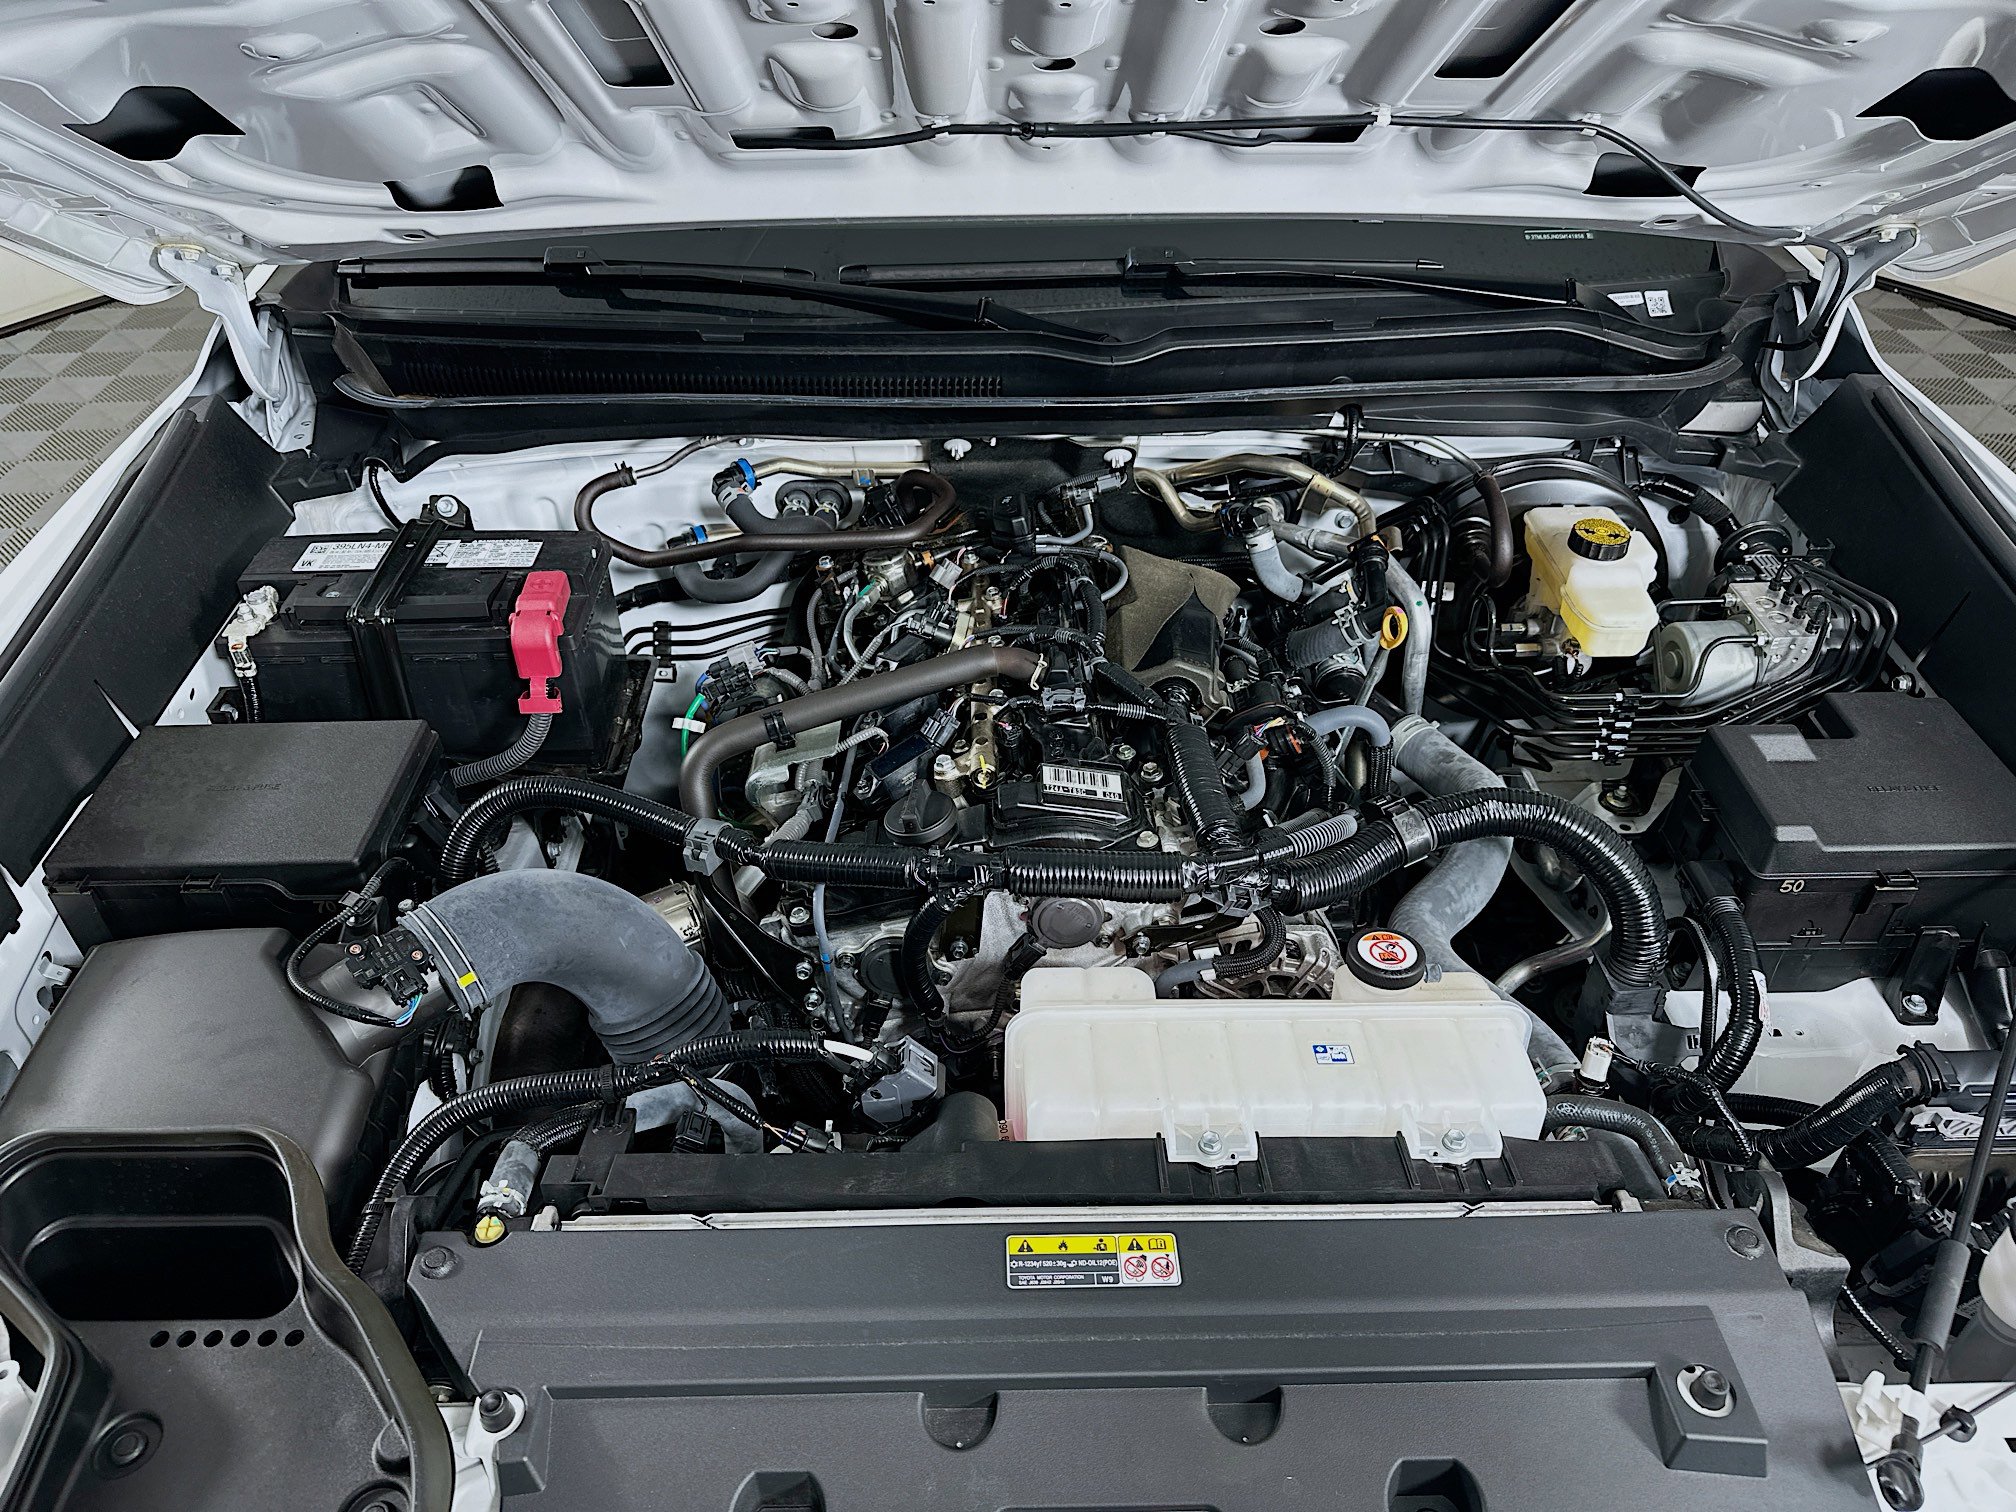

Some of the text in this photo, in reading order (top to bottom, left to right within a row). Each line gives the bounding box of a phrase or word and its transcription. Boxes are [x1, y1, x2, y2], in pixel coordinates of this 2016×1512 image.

[1779, 879, 1805, 893] 50
[312, 900, 336, 914] 70
[1018, 1260, 1042, 1268] R-1234yf
[1101, 1275, 1114, 1283] W9
